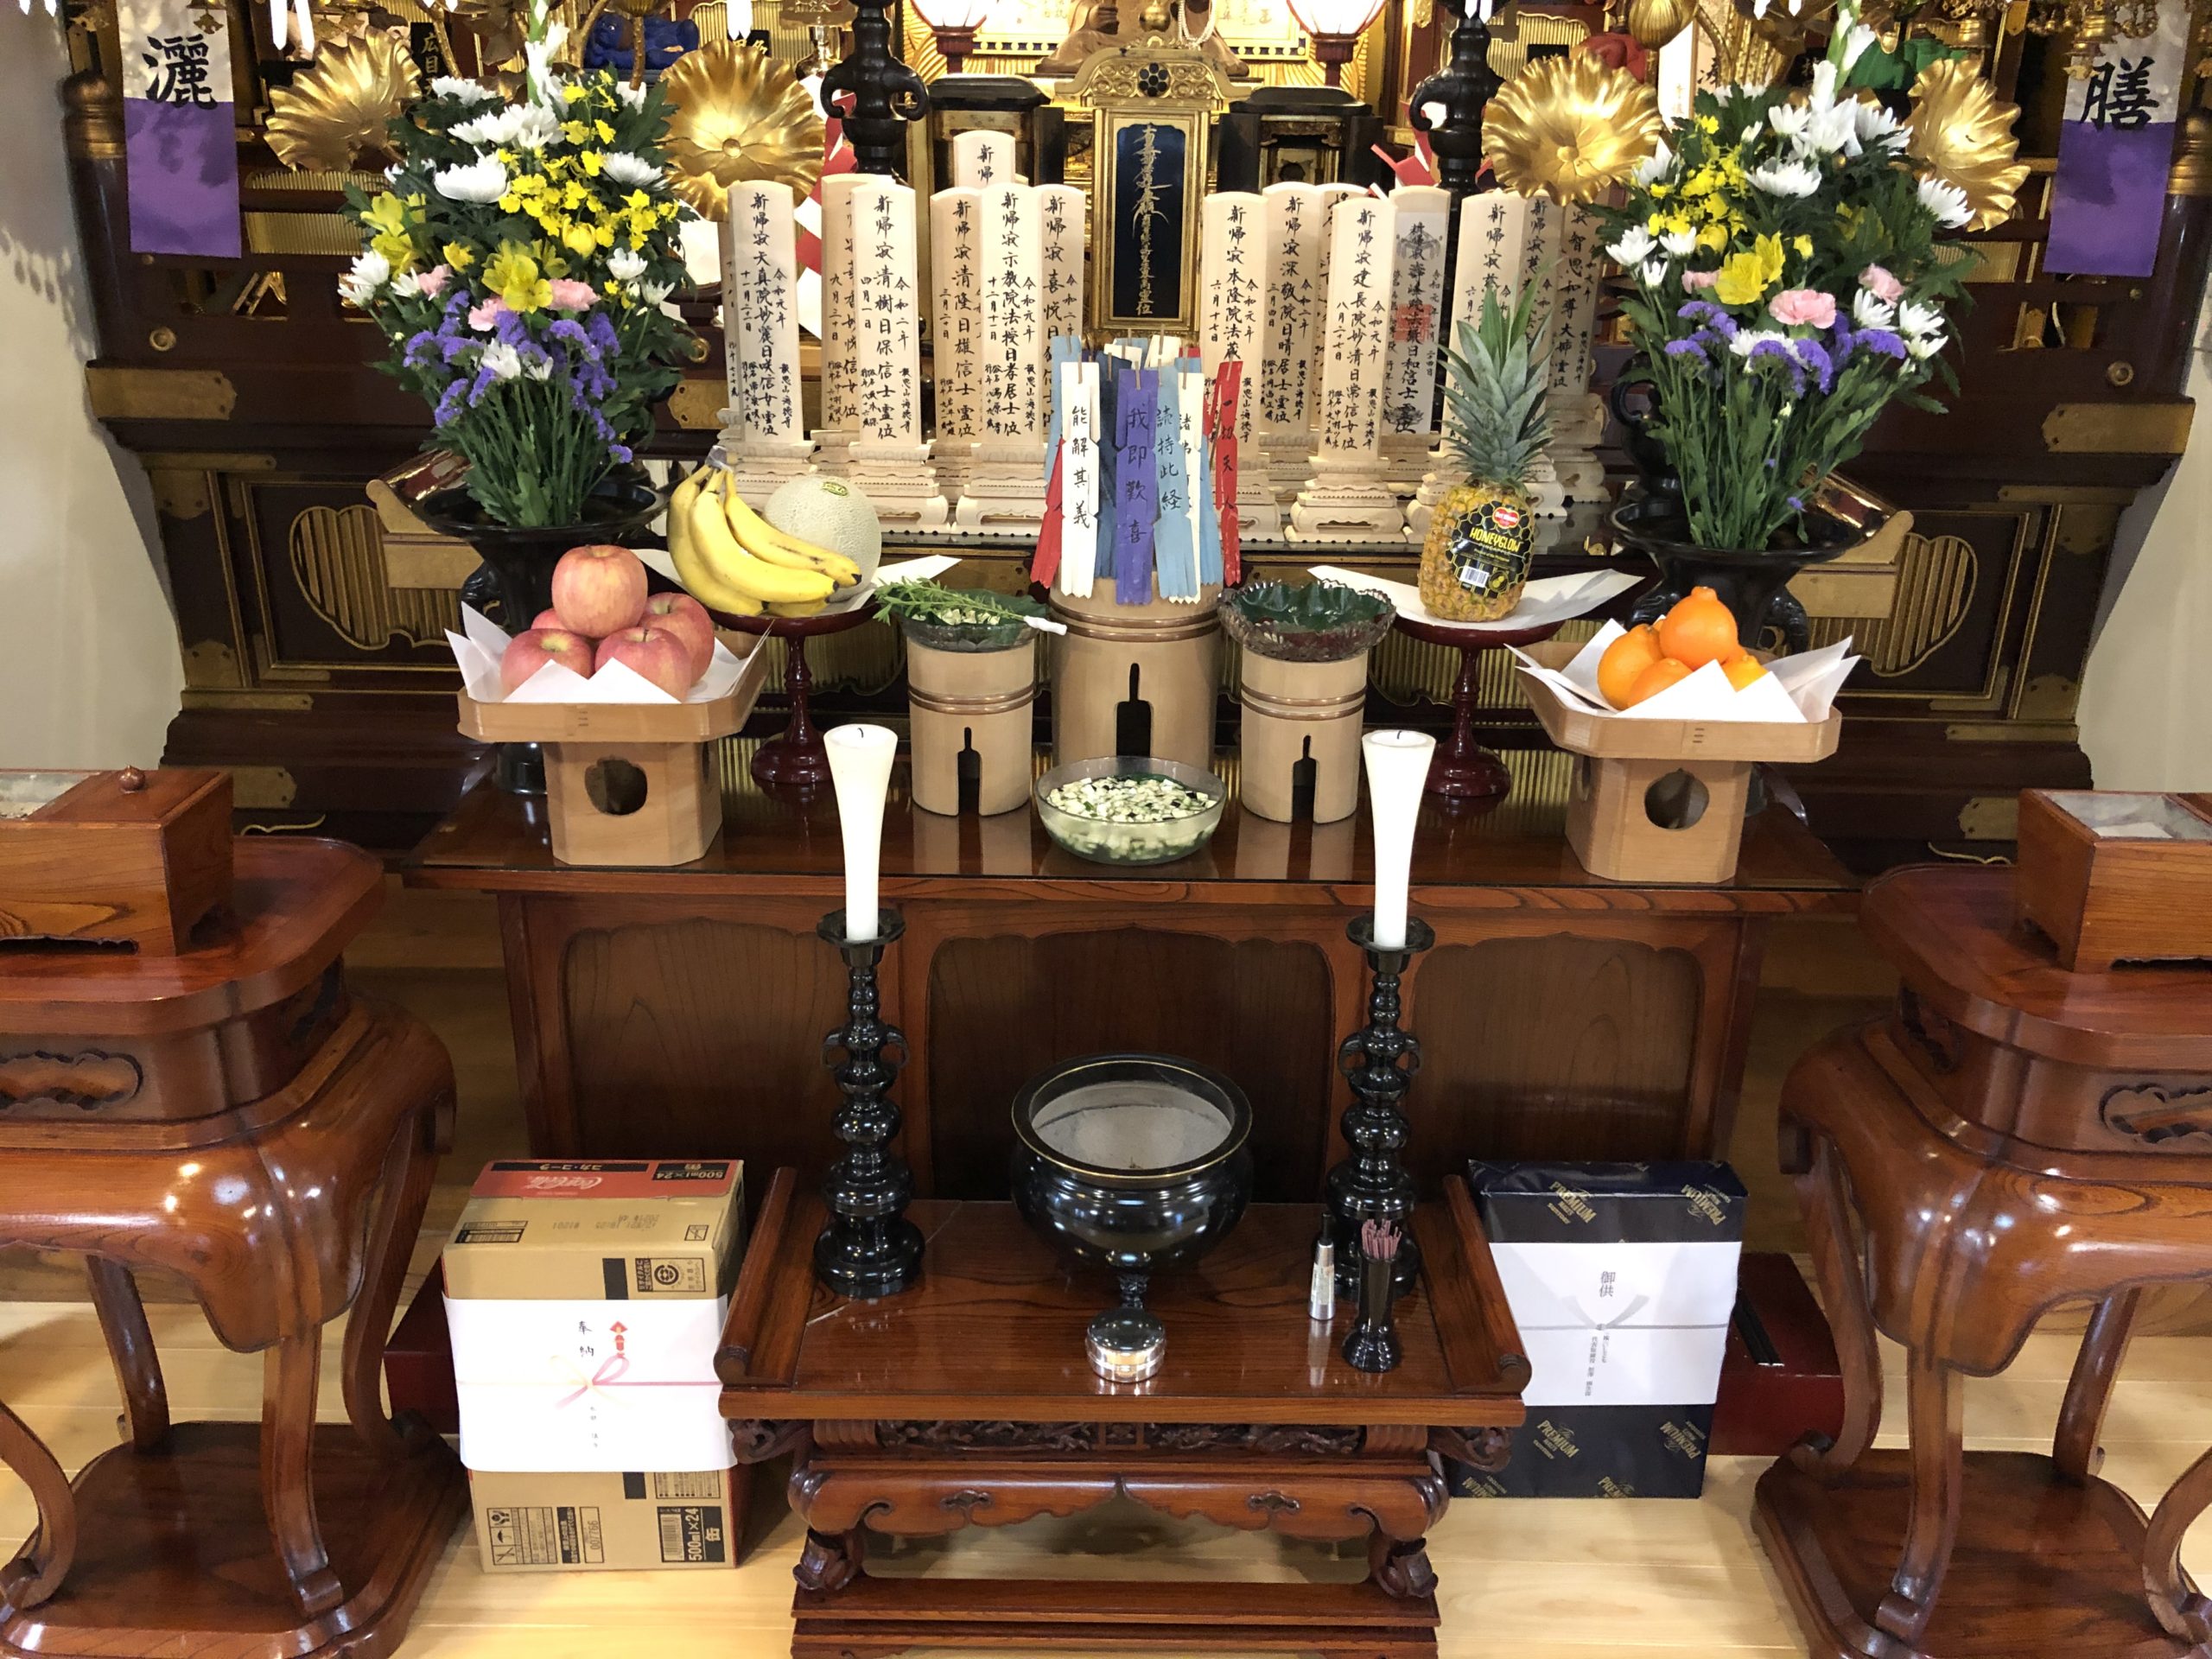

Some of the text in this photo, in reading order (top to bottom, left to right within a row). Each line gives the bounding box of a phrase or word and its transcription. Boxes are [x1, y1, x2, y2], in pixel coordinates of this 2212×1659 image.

[142, 34, 218, 111] 灑
[2080, 56, 2159, 131] 膳
[894, 276, 911, 352] 令和二年
[1022, 276, 1036, 345] 令和元年
[1243, 278, 1259, 345] 令和元年
[1368, 301, 1386, 364] 令和元年
[1071, 406, 1090, 528] 能解其義
[1469, 527, 1522, 552] HONEYGLOW
[1549, 1181, 1597, 1224] PREMIUM
[1681, 1184, 1726, 1225] PREMIUM
[1599, 1271, 1616, 1297] 御供
[579, 1320, 594, 1357] 奉納
[1536, 1420, 1580, 1459] PREMIUM
[1660, 1421, 1701, 1459] PREMIUM
[684, 1507, 702, 1560] 500ml×24
[705, 1527, 721, 1541] 缶
